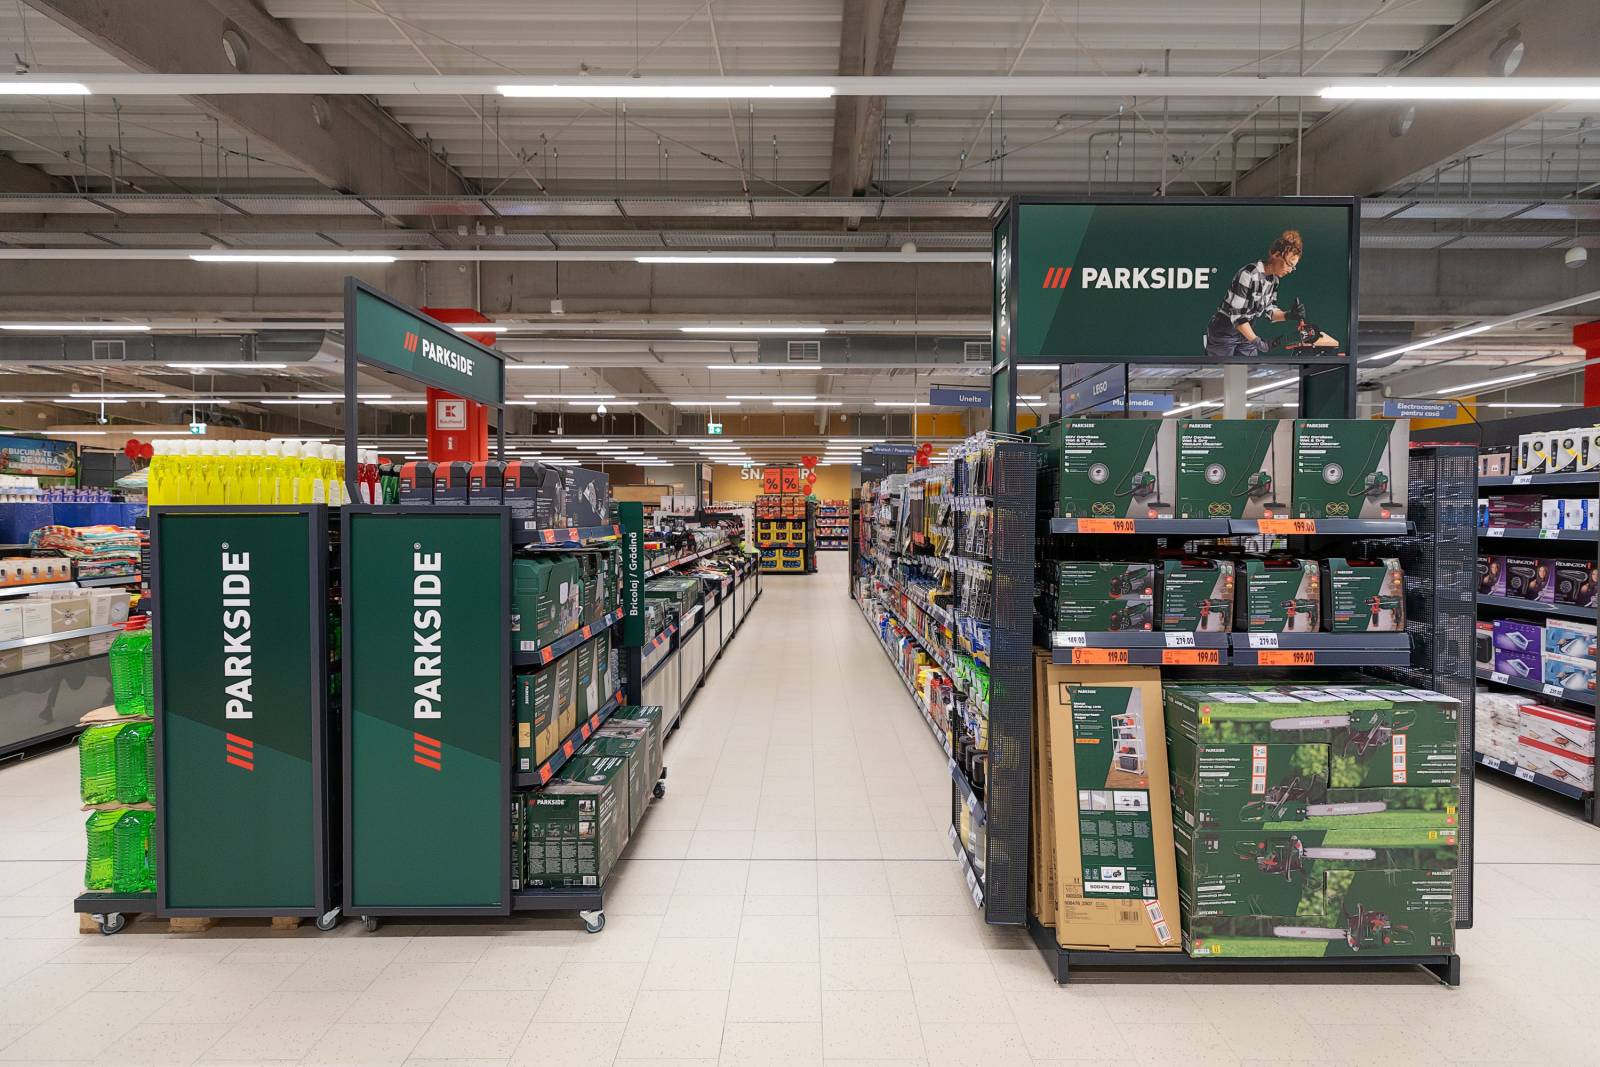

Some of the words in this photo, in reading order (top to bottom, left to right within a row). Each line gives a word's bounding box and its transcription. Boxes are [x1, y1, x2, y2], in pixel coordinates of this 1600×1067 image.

[1092, 381, 1108, 396] LEGO
[959, 395, 982, 403] Unelte
[1397, 402, 1445, 411] Electrocasnice
[1113, 520, 1134, 531] 199.00
[1294, 520, 1315, 532] 199.00
[1507, 558, 1534, 566] REMINGTON
[629, 579, 639, 616] Bricolaj
[1176, 637, 1193, 645] 279.00
[1259, 637, 1277, 646] 279.00
[1108, 651, 1127, 663] 119.00
[1197, 651, 1218, 663] 199.00
[1293, 652, 1314, 663] 199.00
